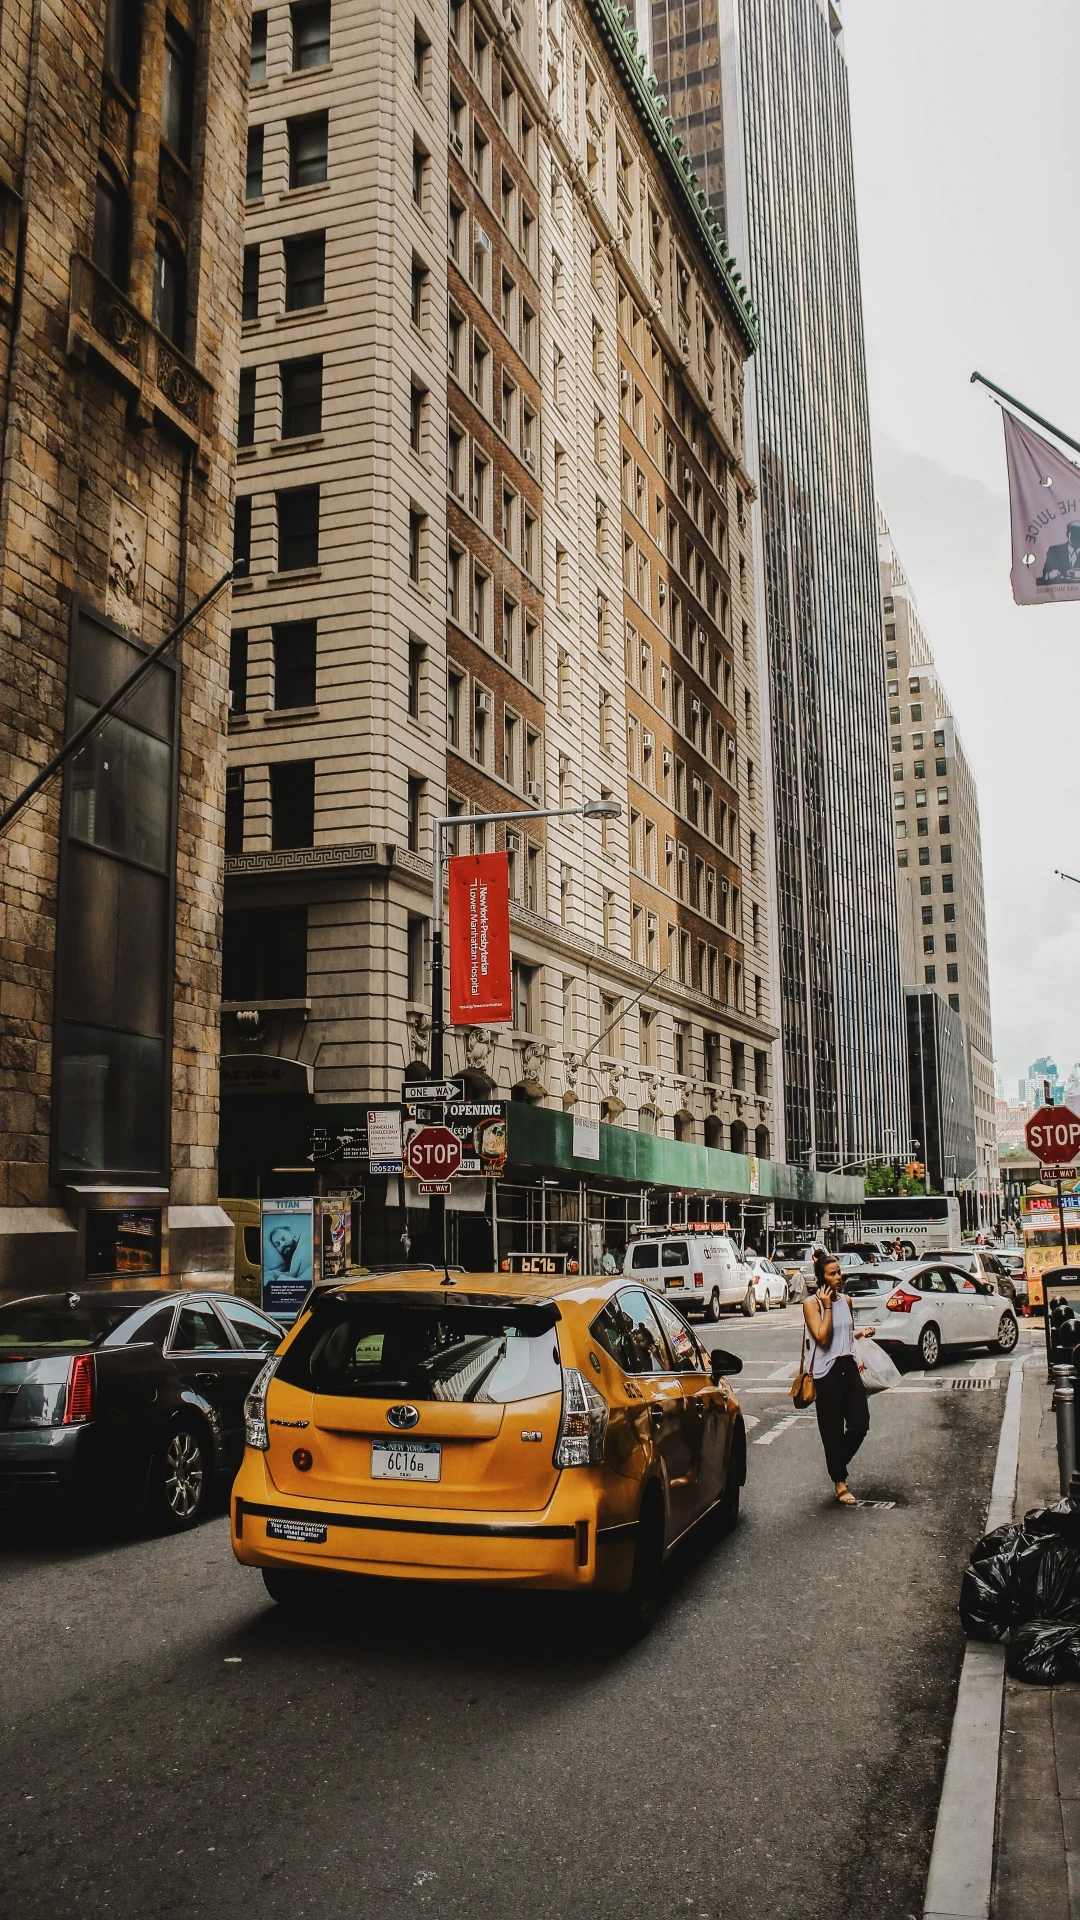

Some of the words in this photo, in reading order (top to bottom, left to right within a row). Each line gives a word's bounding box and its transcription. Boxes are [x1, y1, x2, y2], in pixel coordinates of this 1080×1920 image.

[470, 961, 479, 996] Hospital
[410, 1088, 428, 1097] ONE
[436, 1086, 455, 1096] WAY
[450, 1104, 501, 1116] OPENING
[370, 1113, 375, 1122] 3
[1030, 1123, 1080, 1147] STOP
[412, 1143, 458, 1165] STOP
[388, 1443, 404, 1451] NEW
[406, 1444, 424, 1453] YORK
